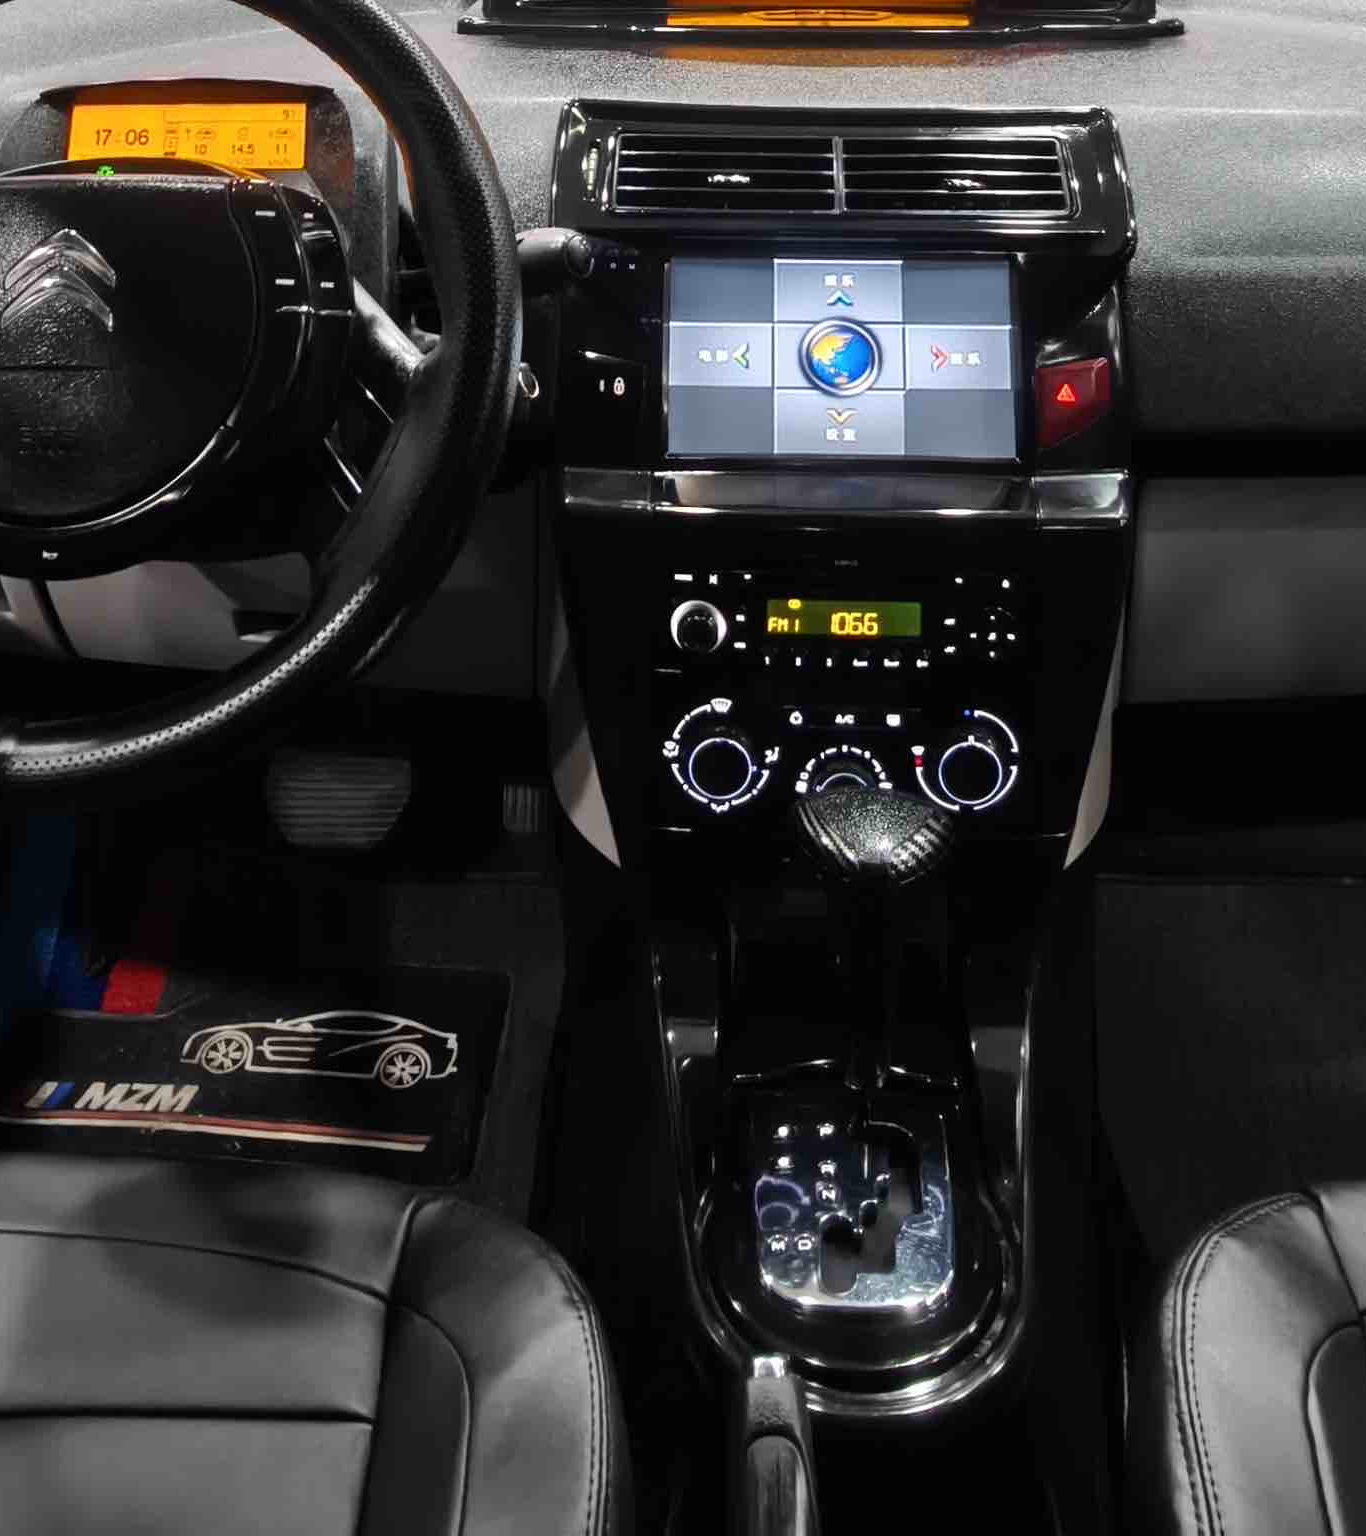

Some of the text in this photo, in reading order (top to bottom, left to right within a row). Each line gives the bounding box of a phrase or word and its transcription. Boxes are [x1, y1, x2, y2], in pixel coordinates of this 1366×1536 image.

[94, 128, 151, 148] 17:06
[834, 713, 855, 725] A/C
[73, 1080, 200, 1113] MZM
[821, 1188, 836, 1201] N
[770, 1238, 787, 1252] M
[797, 1238, 813, 1252] D
